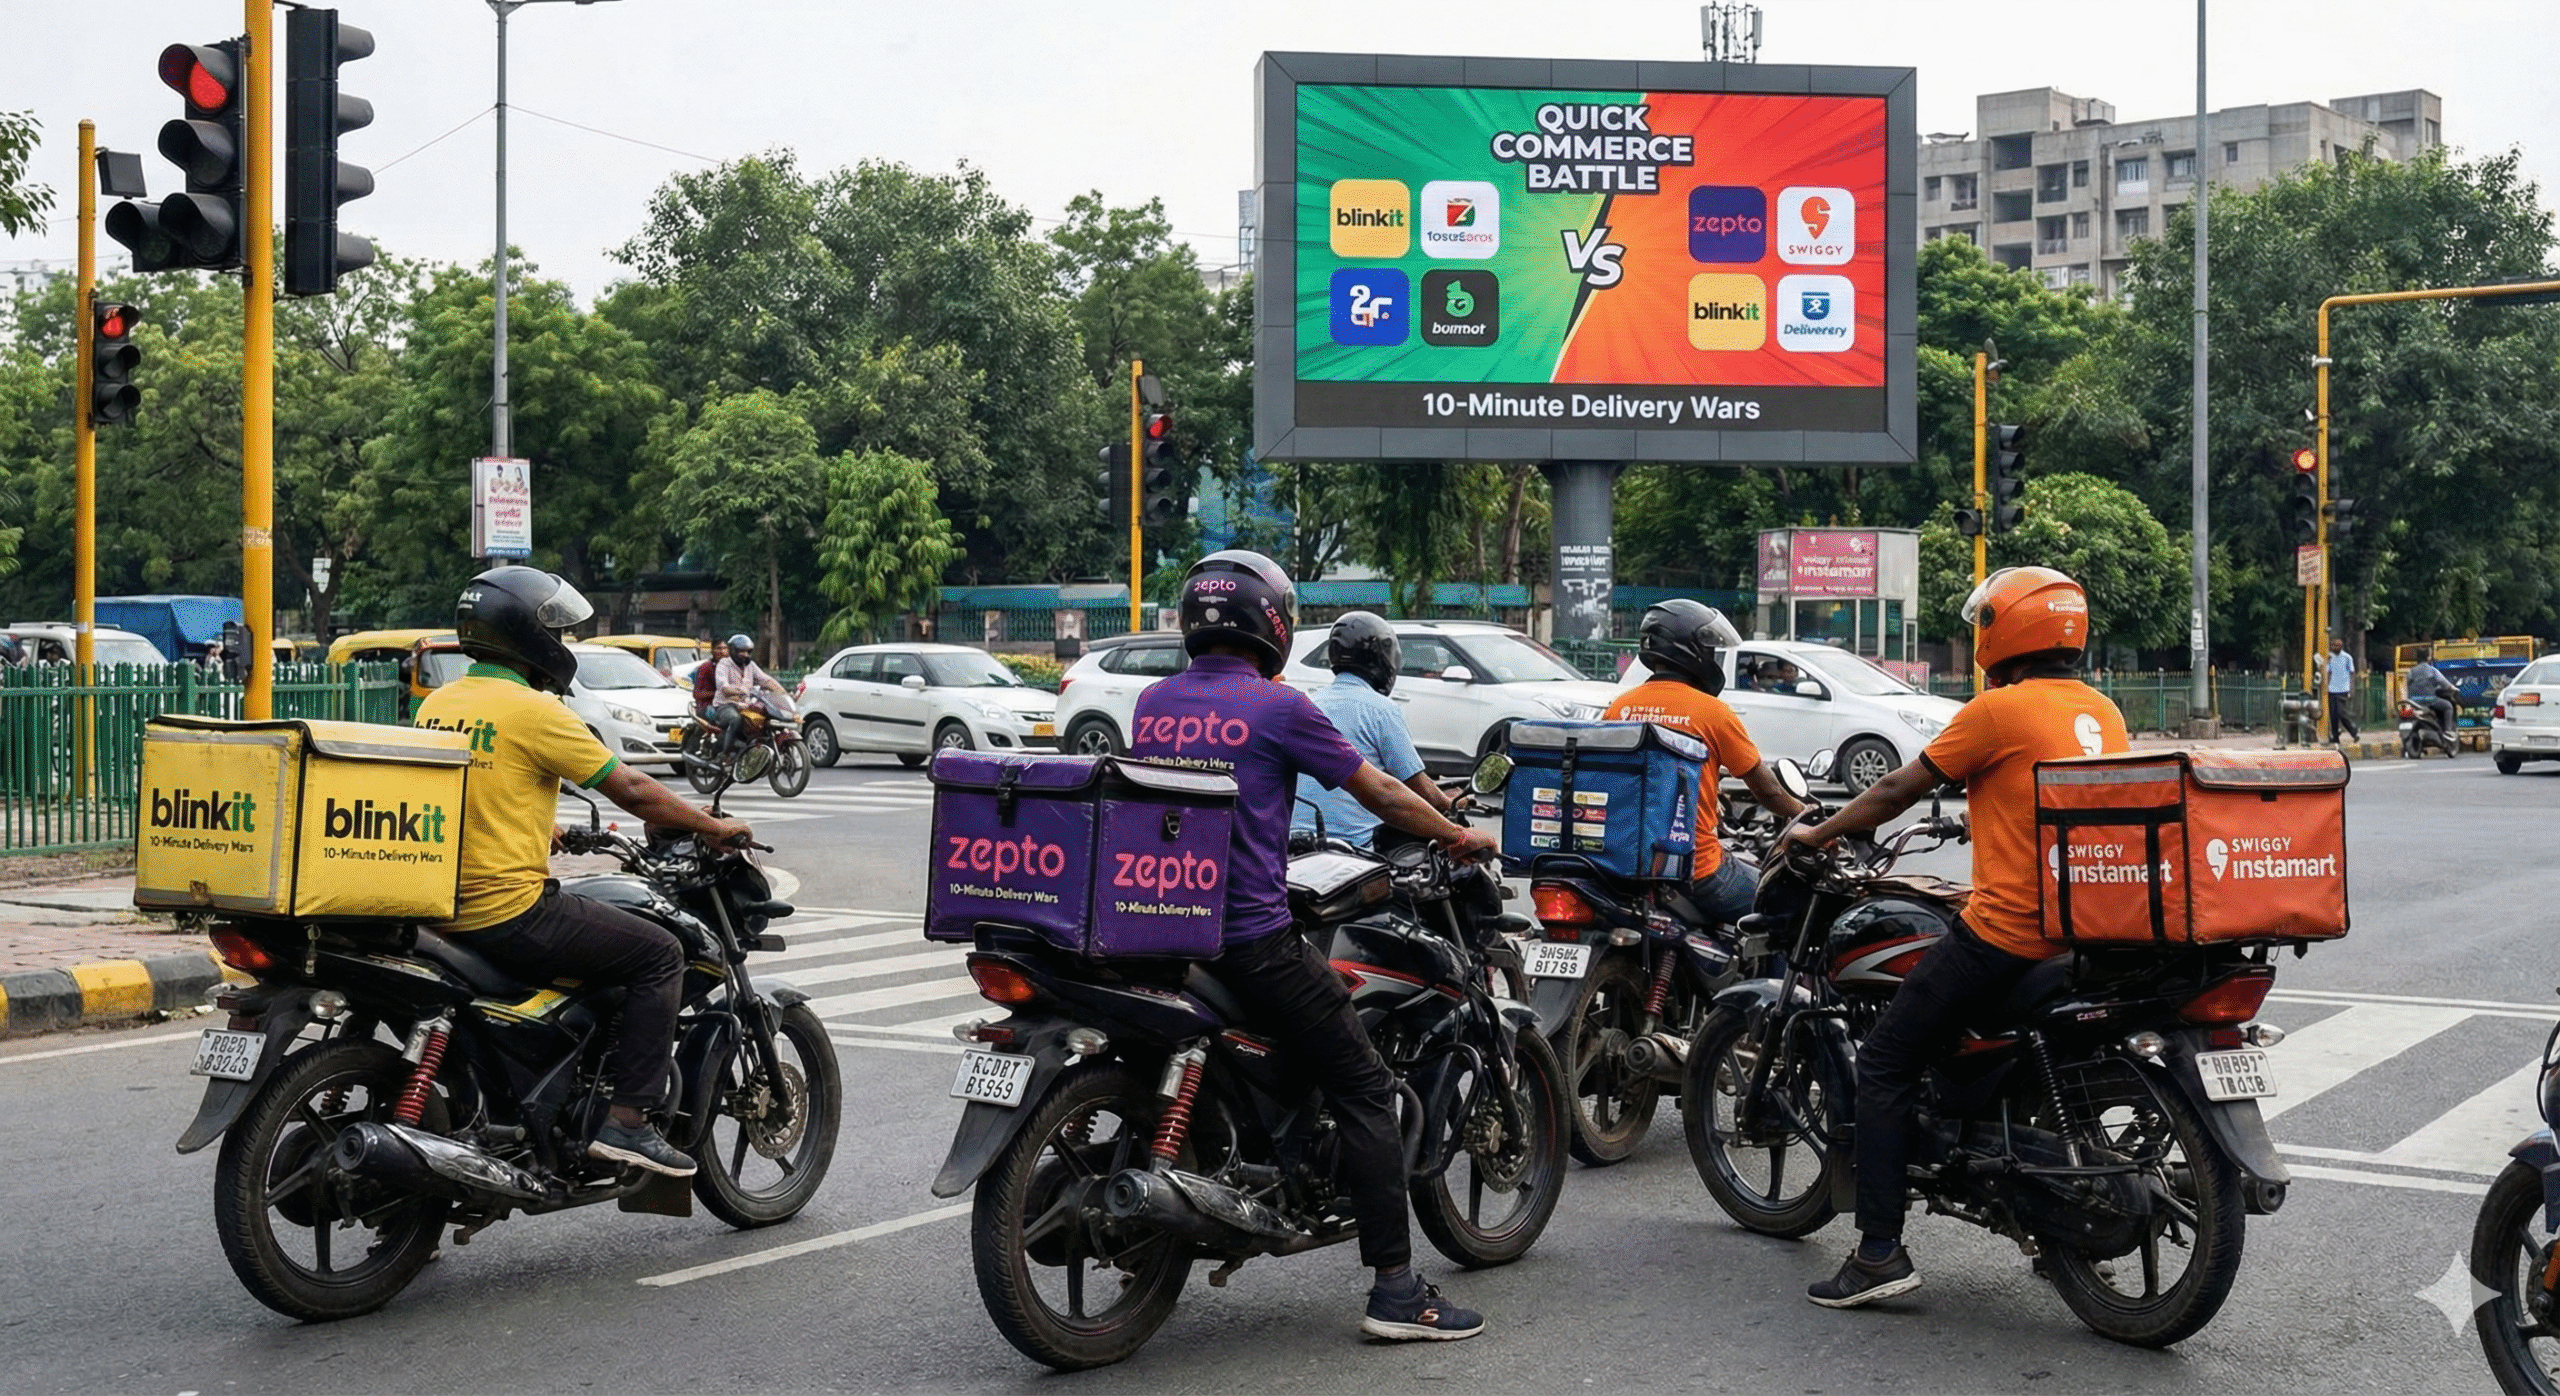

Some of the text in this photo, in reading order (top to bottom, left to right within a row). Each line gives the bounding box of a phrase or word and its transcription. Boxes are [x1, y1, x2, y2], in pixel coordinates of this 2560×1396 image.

[1538, 105, 1649, 134] QUICK
[1493, 133, 1693, 161] COMMERCE
[1528, 164, 1657, 190] BATTLE
[1336, 208, 1404, 228] blinkit
[1693, 214, 1763, 236] zepto
[1563, 228, 1622, 286] VS
[1788, 244, 1844, 256] SWIGGY
[1694, 302, 1761, 321] blinkit
[1423, 392, 1761, 424] 10-Minute Delivery Wars
[1136, 711, 1249, 753] zepto
[151, 788, 257, 833] blinkit
[324, 798, 446, 843] blinkit
[947, 834, 1065, 882] zepto
[2067, 844, 2124, 858] SWIGGY
[2231, 836, 2292, 853] SWIGGY
[1113, 850, 1218, 898] zepto
[2232, 853, 2336, 879] instamart
